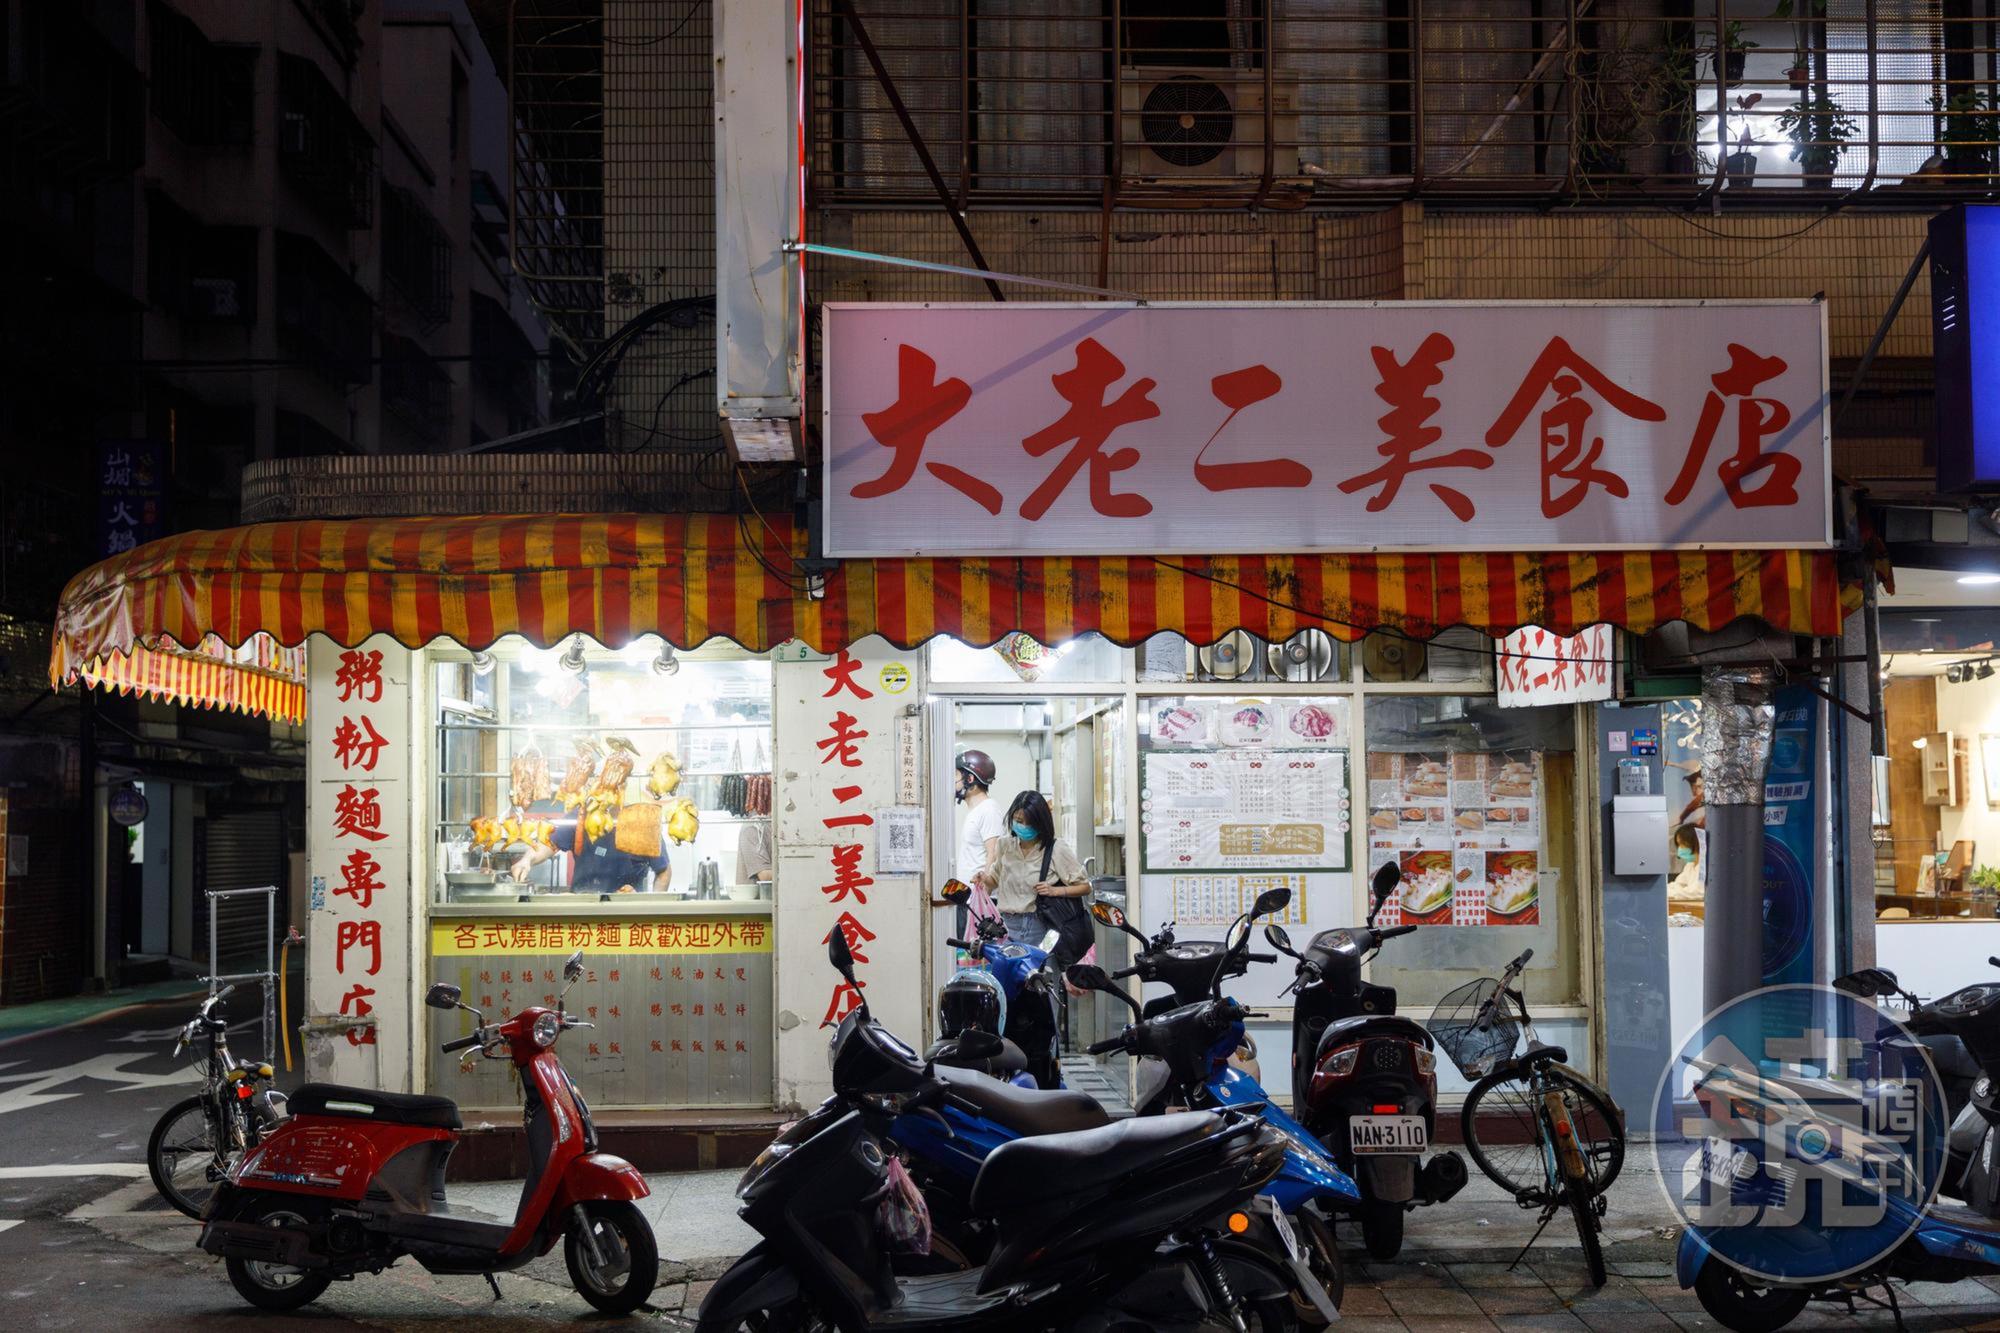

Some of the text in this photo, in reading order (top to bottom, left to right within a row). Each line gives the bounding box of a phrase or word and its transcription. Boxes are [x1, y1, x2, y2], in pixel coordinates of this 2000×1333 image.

[851, 332, 1801, 521] 大老二美食店
[1499, 624, 1606, 693] 大老二美食店
[332, 650, 390, 1046] 粥粉麵專門店
[816, 650, 876, 1029] 大老二美食店
[1352, 1125, 1424, 1146] NAN-3110
